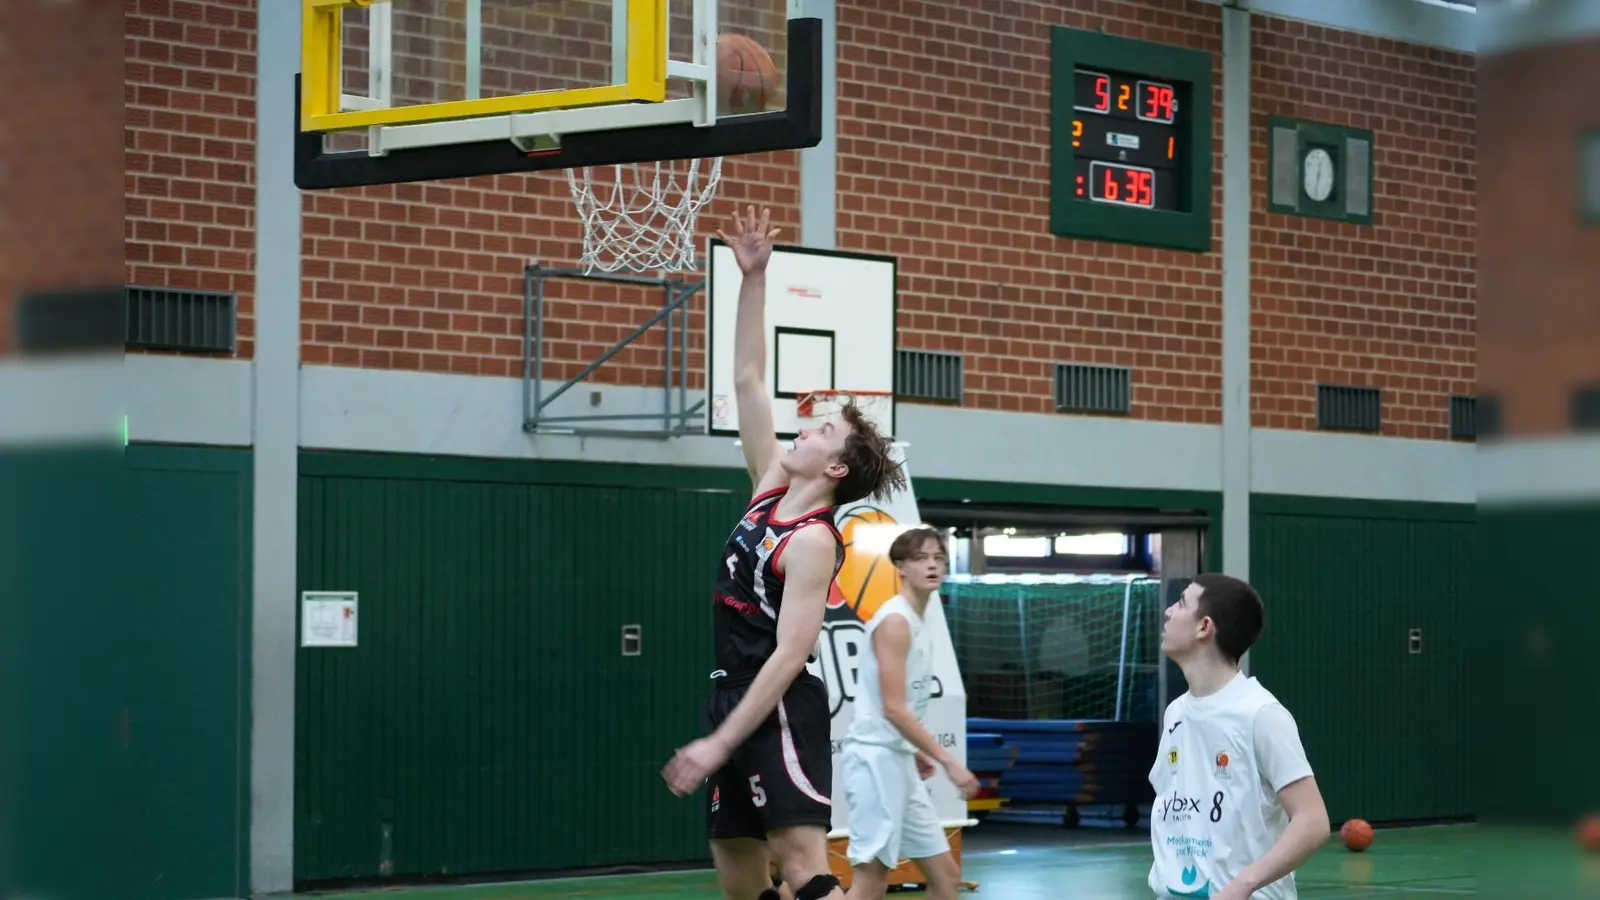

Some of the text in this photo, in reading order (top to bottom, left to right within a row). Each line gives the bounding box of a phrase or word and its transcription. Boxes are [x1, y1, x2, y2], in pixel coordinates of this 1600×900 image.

[1095, 76, 1174, 119] 5 2 39
[1167, 136, 1175, 160] 1
[748, 774, 768, 808] 5
[1209, 790, 1225, 823] 8
